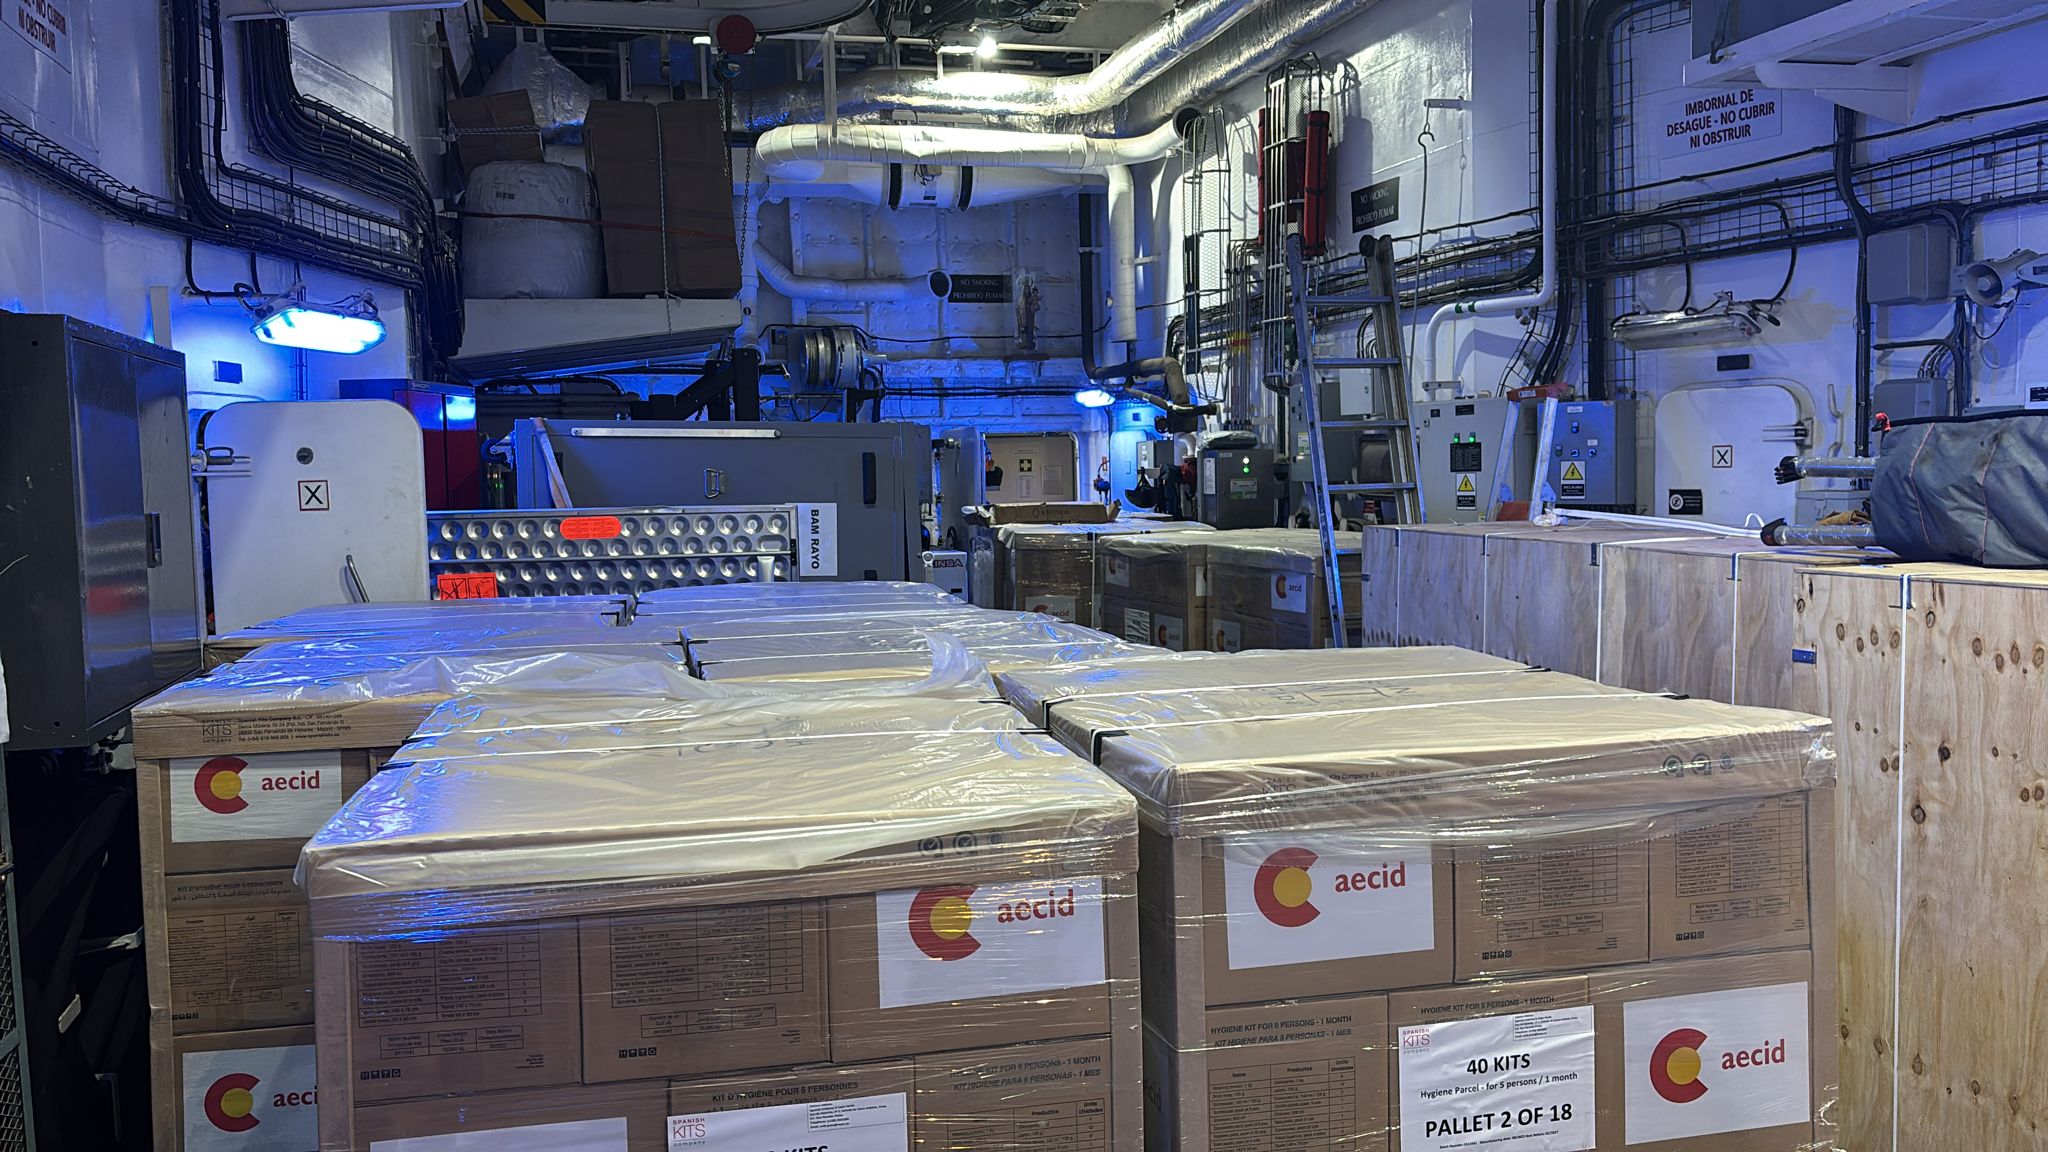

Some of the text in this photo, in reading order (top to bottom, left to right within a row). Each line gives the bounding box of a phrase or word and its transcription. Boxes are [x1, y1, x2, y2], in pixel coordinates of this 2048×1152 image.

[26, 13, 56, 54] OBSTRUIR
[1685, 89, 1754, 116] IMBORNAL DE
[1667, 116, 1711, 137] DESAGUE
[1720, 110, 1736, 125] NO
[1738, 102, 1775, 121] CUBRIR
[1690, 124, 1751, 148] NI OBSTRUIR
[811, 509, 820, 570] BAM RAYO
[202, 724, 231, 736] KITS
[261, 770, 320, 791] aecid
[1334, 861, 1406, 893] aecid
[997, 889, 1074, 923] aecid
[1421, 1005, 1452, 1015] HYGIENE
[1486, 999, 1520, 1009] PERSONS
[1528, 996, 1555, 1004] MONTH
[1210, 1024, 1244, 1035] HYGIENE
[1244, 1022, 1256, 1032] KIT
[1257, 1021, 1273, 1030] FOR
[1280, 1017, 1315, 1028] PERSONS
[1325, 1015, 1352, 1024] MONTH
[1214, 1039, 1227, 1048] KIT
[1227, 1036, 1258, 1047] HIGIENE
[1258, 1034, 1280, 1043] PARA
[1285, 1030, 1326, 1041] PERSONAS
[1335, 1028, 1352, 1037] MES
[1403, 1034, 1430, 1048] KITS
[999, 1064, 1017, 1073] FOR
[1024, 1060, 1062, 1071] PERSONS
[1072, 1055, 1101, 1065] MONTH
[1467, 1054, 1531, 1075] 40 KITS
[1721, 1038, 1785, 1070] aecid
[1001, 1076, 1023, 1086] PARA
[1030, 1073, 1073, 1084] PERSONAS
[1084, 1069, 1101, 1077] MES
[1420, 1087, 1453, 1099] Hygiene
[1454, 1084, 1479, 1094] Parcel
[1486, 1082, 1498, 1091] for
[1499, 1081, 1505, 1089] 5
[1506, 1078, 1537, 1090] persons
[1538, 1075, 1543, 1085] /
[1545, 1075, 1550, 1083] 1
[1552, 1072, 1578, 1082] month
[273, 1084, 318, 1108] aeci
[712, 1093, 725, 1102] KIT
[775, 1086, 801, 1097] POUR
[806, 1081, 859, 1093] PERSONNES
[672, 1116, 706, 1125] SPANISH
[1425, 1103, 1573, 1138] PALLET 2 OF 18
[672, 1123, 706, 1140] KITS
